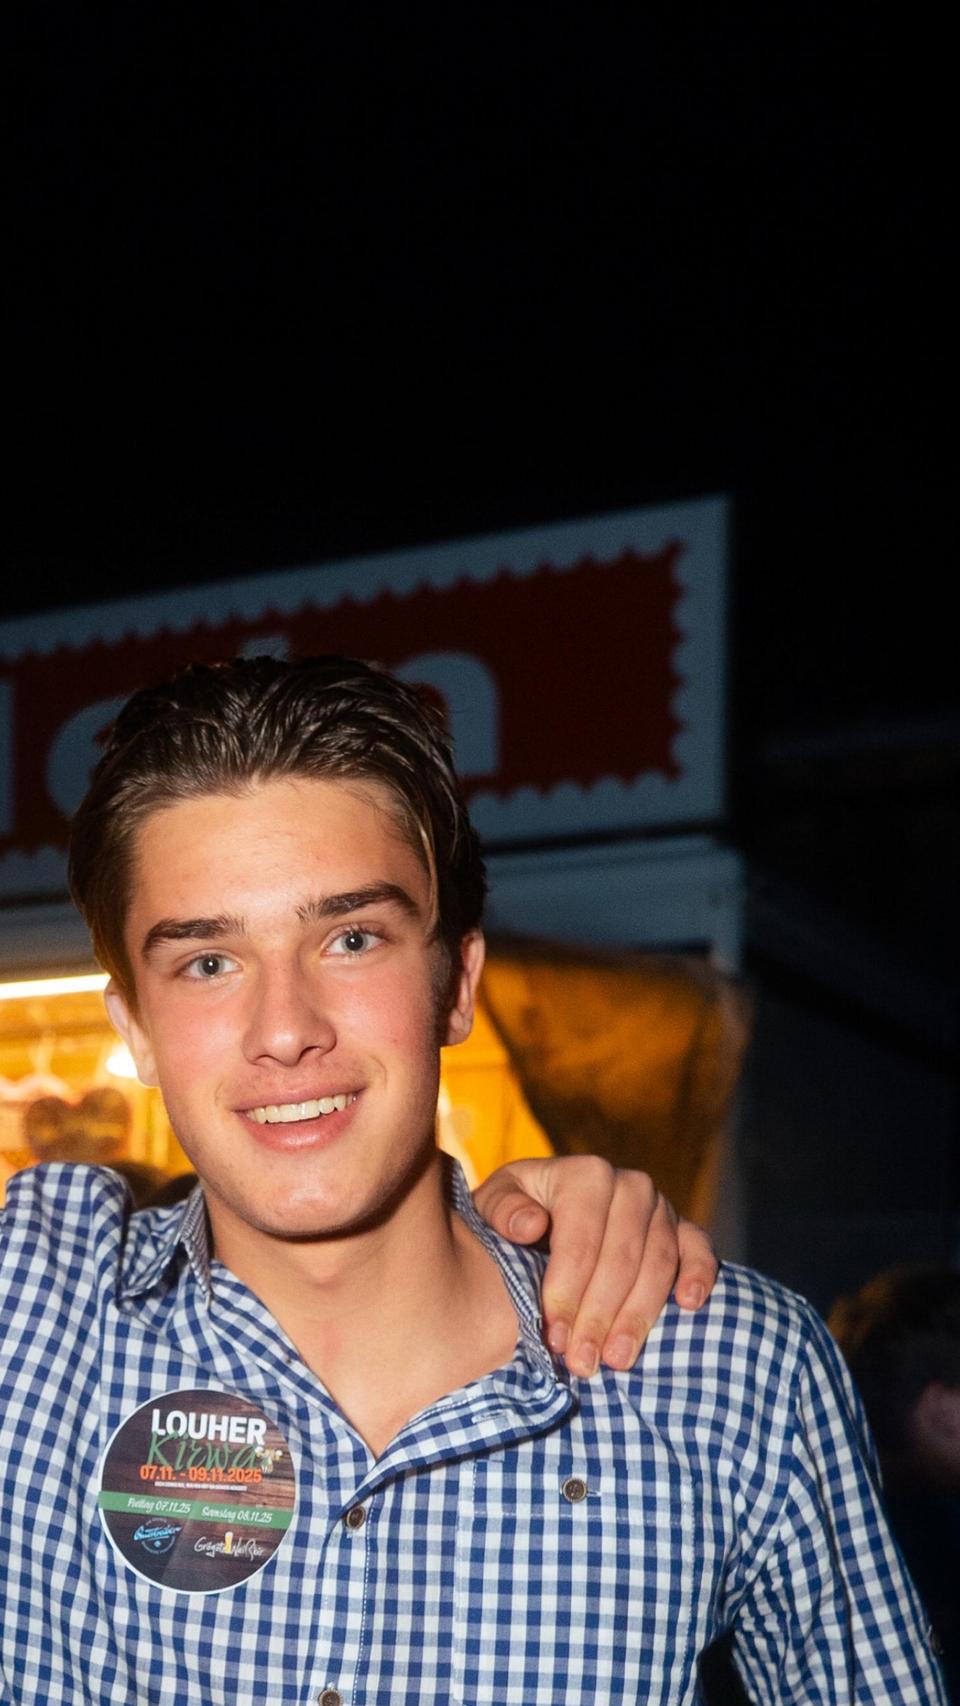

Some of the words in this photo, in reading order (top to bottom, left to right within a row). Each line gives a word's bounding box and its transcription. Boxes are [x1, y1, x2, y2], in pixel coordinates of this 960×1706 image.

[151, 1408, 267, 1446] LOUHER
[140, 1465, 176, 1480] 07.11.
[188, 1467, 262, 1483] 09.11.2025
[155, 1500, 192, 1514] 07.11.25
